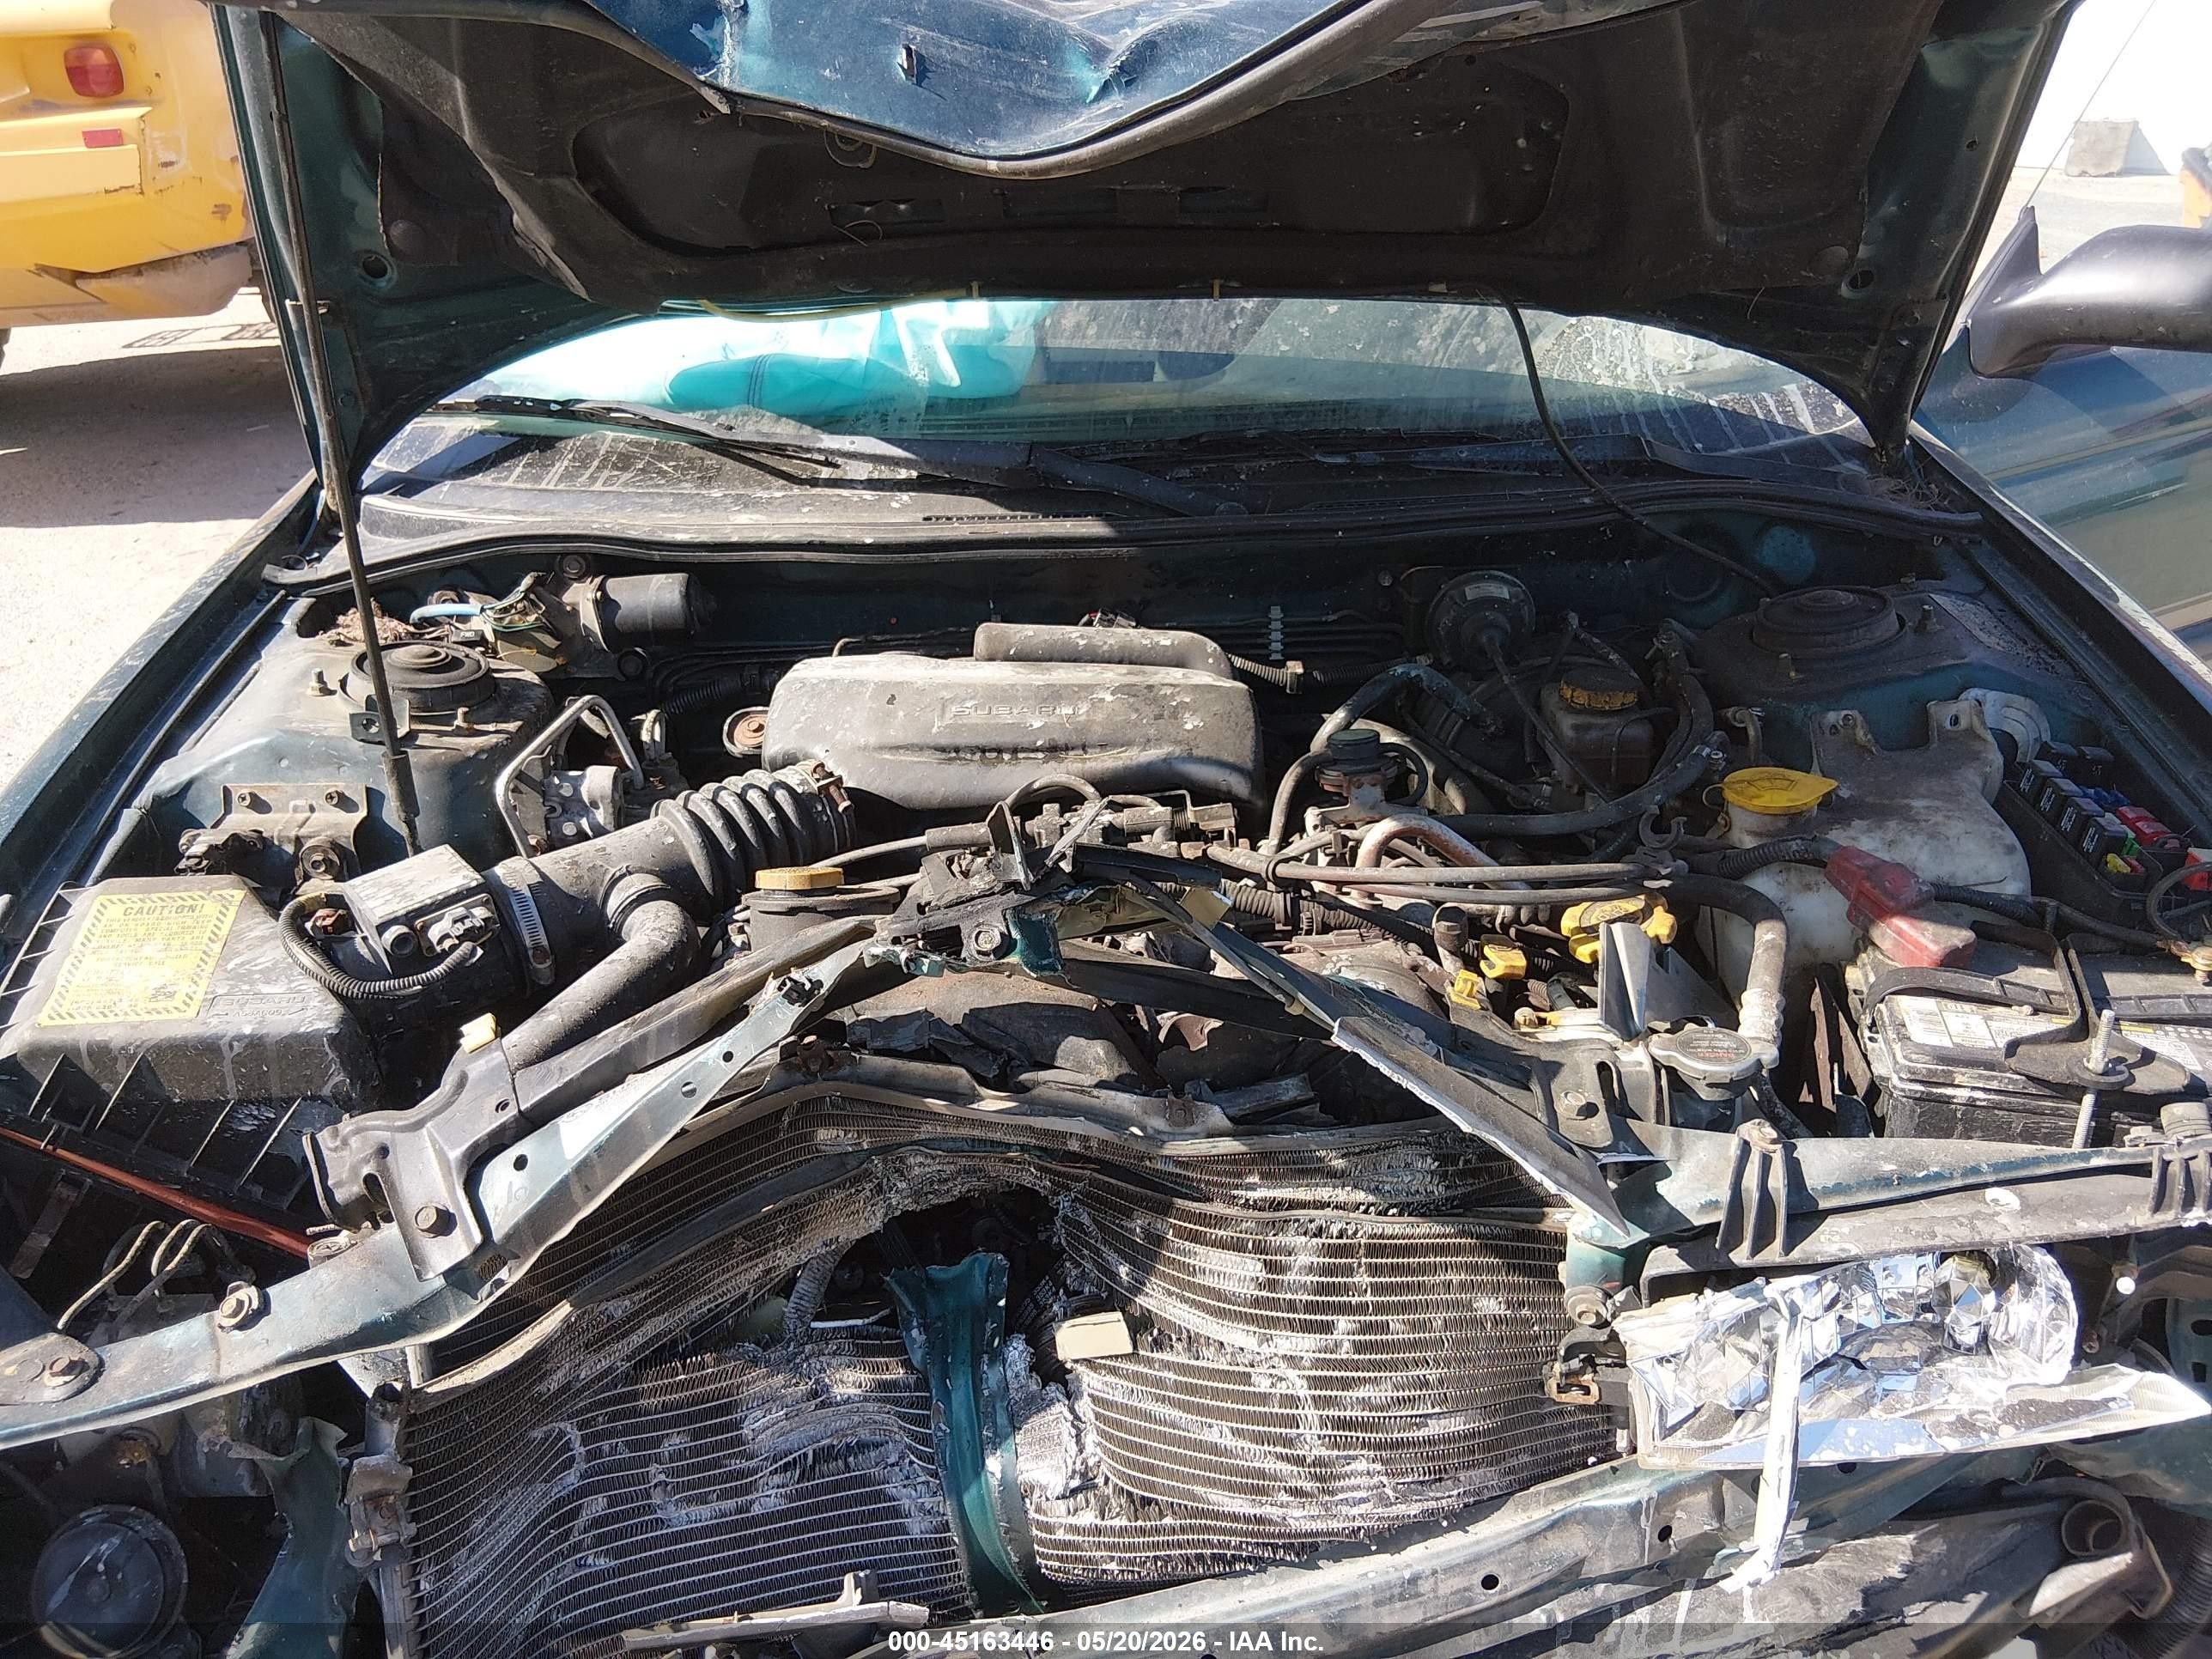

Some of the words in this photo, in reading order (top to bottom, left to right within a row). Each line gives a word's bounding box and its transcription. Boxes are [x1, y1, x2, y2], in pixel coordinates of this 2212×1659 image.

[952, 704, 1079, 716] SUBARU
[123, 904, 204, 916] CAUTION!
[223, 996, 306, 1006] SUBARU
